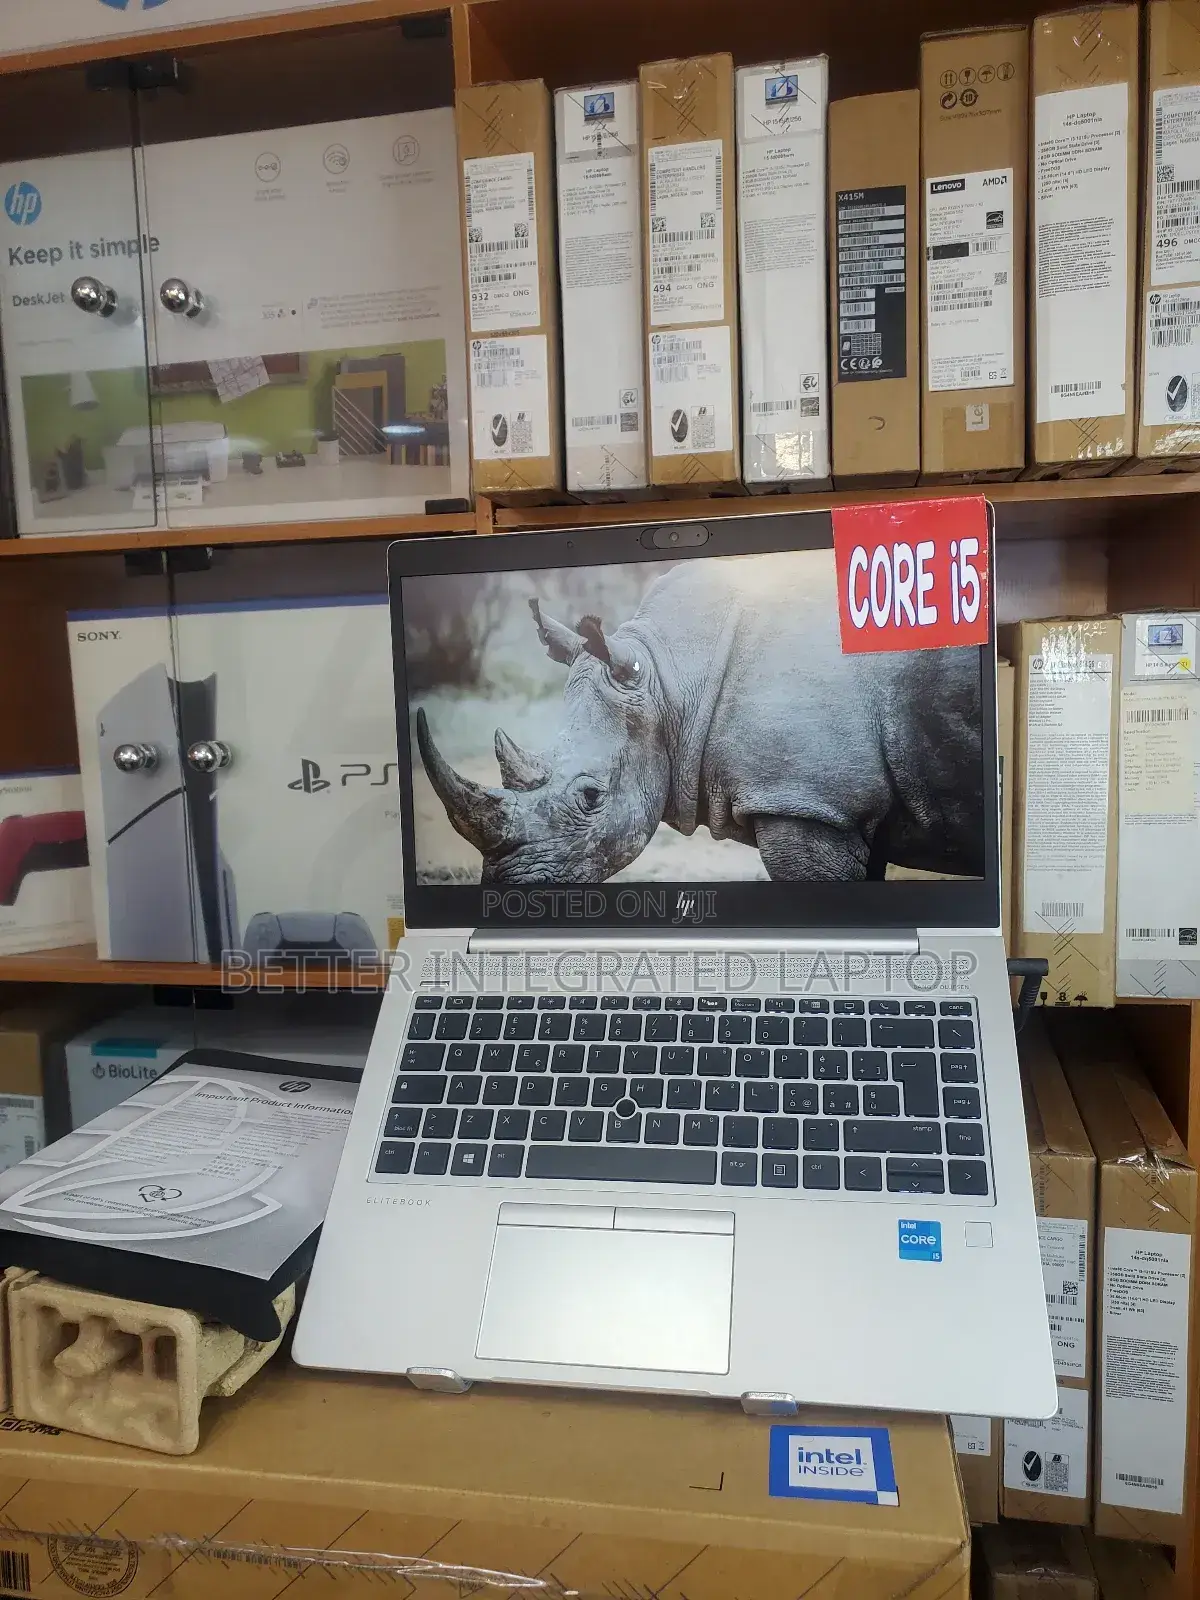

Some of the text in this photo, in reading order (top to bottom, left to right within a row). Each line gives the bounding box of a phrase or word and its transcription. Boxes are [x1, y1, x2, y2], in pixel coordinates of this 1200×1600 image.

[933, 178, 1000, 191] Lenovo AMD
[838, 192, 865, 202] X415M
[1157, 238, 1178, 248] 496
[9, 234, 160, 266] Keep it simple
[653, 284, 672, 292] 494
[697, 281, 714, 289] ONG
[12, 292, 65, 307] DeskJet
[471, 293, 489, 301] 932
[847, 537, 981, 629] CORE i5
[77, 630, 120, 642] SONY
[1059, 992, 1067, 1001] 8
[580, 1028, 586, 1036] 5
[614, 1028, 620, 1036] 6
[652, 1028, 656, 1036] 7
[724, 1030, 732, 1038] 9
[454, 1048, 462, 1056] Q
[558, 1050, 566, 1058] R
[594, 1050, 600, 1058] T
[632, 1050, 638, 1058] Y
[668, 1052, 676, 1060] U
[744, 1054, 752, 1062] O
[782, 1054, 788, 1062] P
[109, 1064, 157, 1079] BioLite
[492, 1082, 498, 1090] S
[526, 1082, 534, 1090] D
[562, 1082, 570, 1090] F
[600, 1084, 608, 1092] G
[636, 1084, 644, 1092] H
[674, 1086, 680, 1094] J
[712, 1086, 720, 1094] K
[752, 1088, 758, 1096] L
[195, 1093, 353, 1114] Important Product Informatio
[802, 1100, 812, 1108] @
[502, 1116, 510, 1124] X
[540, 1116, 548, 1124] C
[578, 1116, 586, 1126] V
[614, 1120, 622, 1128] B
[652, 1120, 660, 1128] N
[692, 1120, 700, 1130] M
[366, 1197, 432, 1207] ELITEBOOK
[1057, 1341, 1075, 1349] ONG
[798, 1447, 861, 1464] intel
